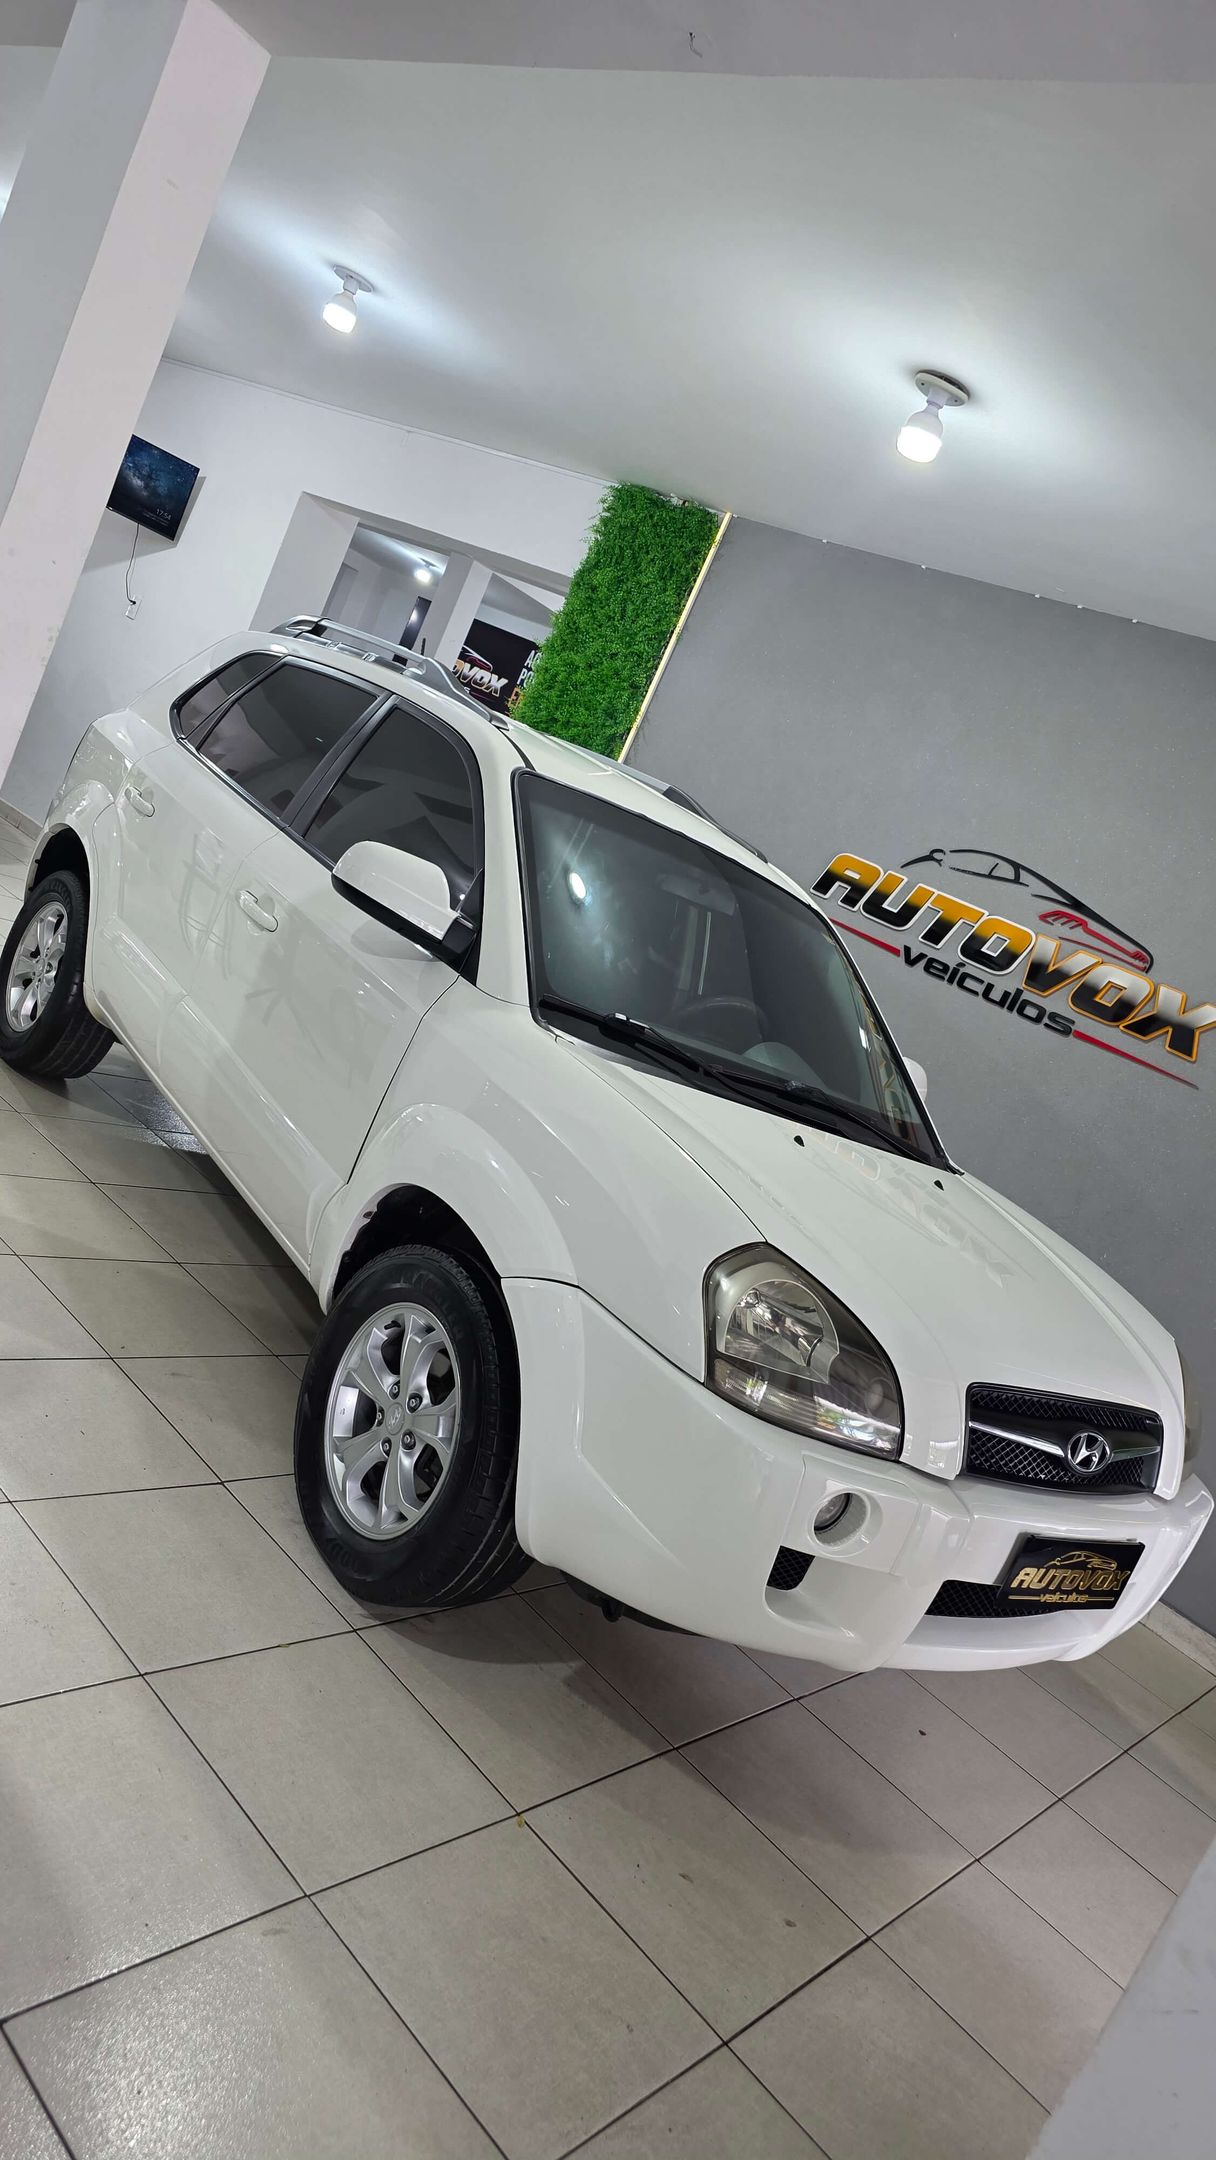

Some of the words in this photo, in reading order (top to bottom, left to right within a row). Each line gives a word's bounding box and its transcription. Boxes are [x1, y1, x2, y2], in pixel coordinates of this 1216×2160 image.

[810, 852, 1216, 1063] AUTOVOX
[902, 943, 1075, 1038] veículos
[1010, 1567, 1132, 1591] AUTOVOX
